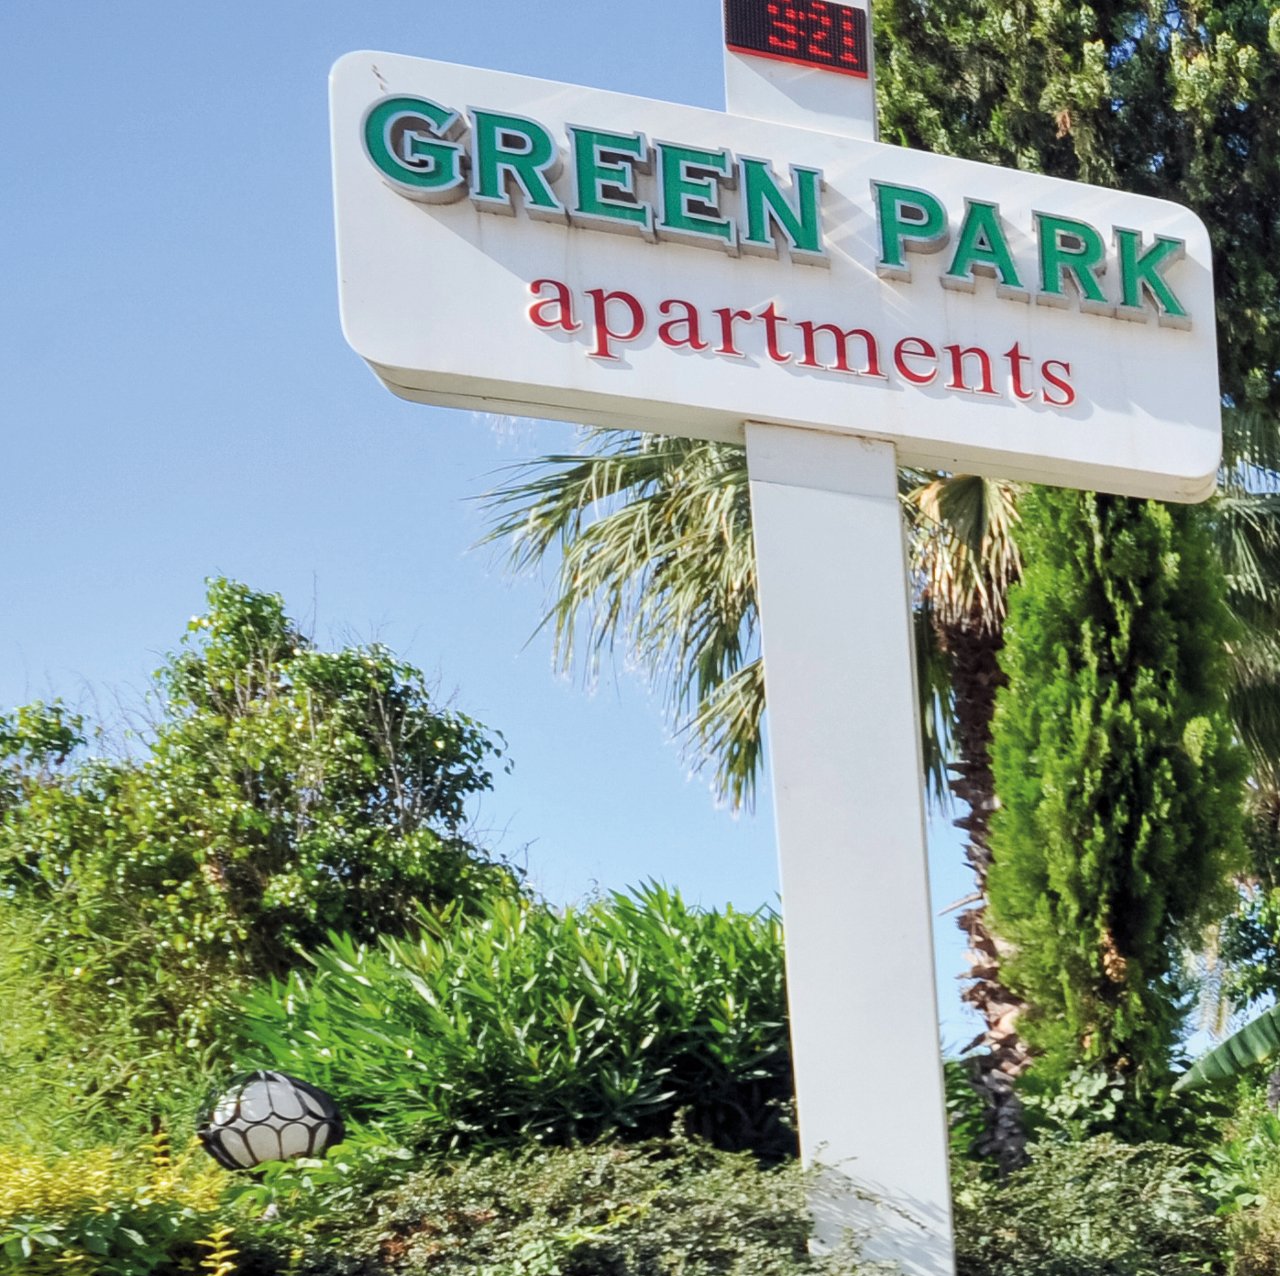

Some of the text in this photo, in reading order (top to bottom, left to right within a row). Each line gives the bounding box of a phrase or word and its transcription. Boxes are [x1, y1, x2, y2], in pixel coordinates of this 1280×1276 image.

[361, 93, 1192, 331] GREEN PARK
[527, 276, 1077, 408] apartments
